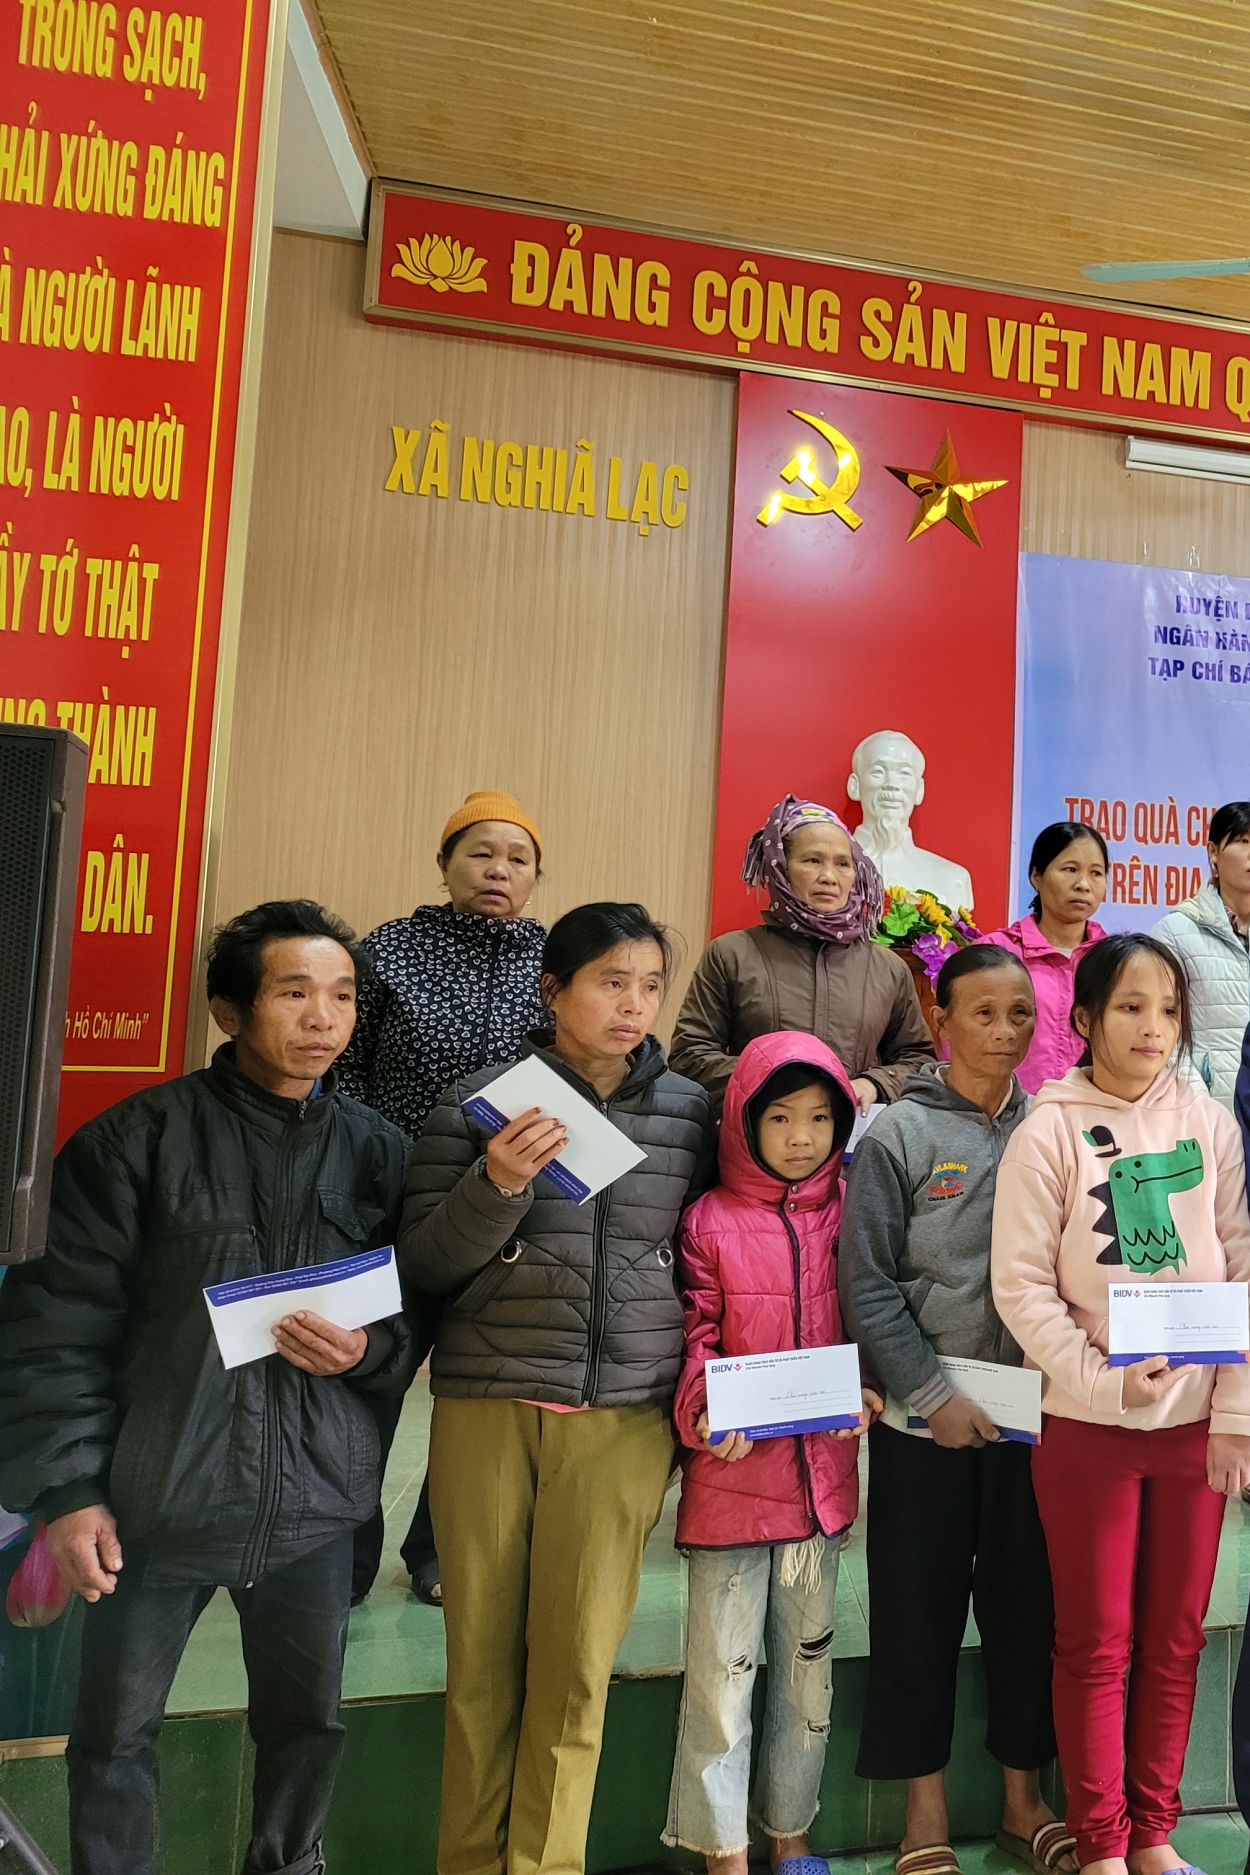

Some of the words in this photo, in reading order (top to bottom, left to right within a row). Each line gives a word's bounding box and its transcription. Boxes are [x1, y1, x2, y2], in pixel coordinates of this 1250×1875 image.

[18, 0, 117, 78] TRONG
[122, 7, 207, 101] SẠCH,
[53, 120, 137, 217] XỨNG
[143, 132, 226, 228] ĐÁNG
[20, 256, 115, 354] NGƯỜI
[120, 266, 202, 363] LÃNH
[511, 223, 671, 327] ĐẢNG
[692, 261, 841, 353] CỘNG
[860, 280, 967, 374] SẢN
[986, 312, 1087, 399] VIỆT
[1101, 336, 1211, 410] NAM
[43, 396, 80, 492] LÀ
[89, 402, 185, 501] NGƯỜI
[385, 419, 449, 498] XÃ
[606, 457, 688, 536] LẠC
[38, 538, 79, 636] TỚ
[84, 544, 160, 658] THẬT
[1154, 624, 1209, 649] NGÂN
[1176, 595, 1238, 622] HUYỆN
[1148, 656, 1185, 681] TẠP
[1191, 660, 1223, 682] CHÍ
[1065, 797, 1127, 842] TRAO
[1134, 796, 1180, 846] QUÀ
[80, 834, 153, 934] DÂN.
[73, 1004, 90, 1039] Hồ
[92, 1011, 114, 1039] Chí
[1113, 1290, 1132, 1298] BIDV
[711, 1363, 733, 1374] BIDV
